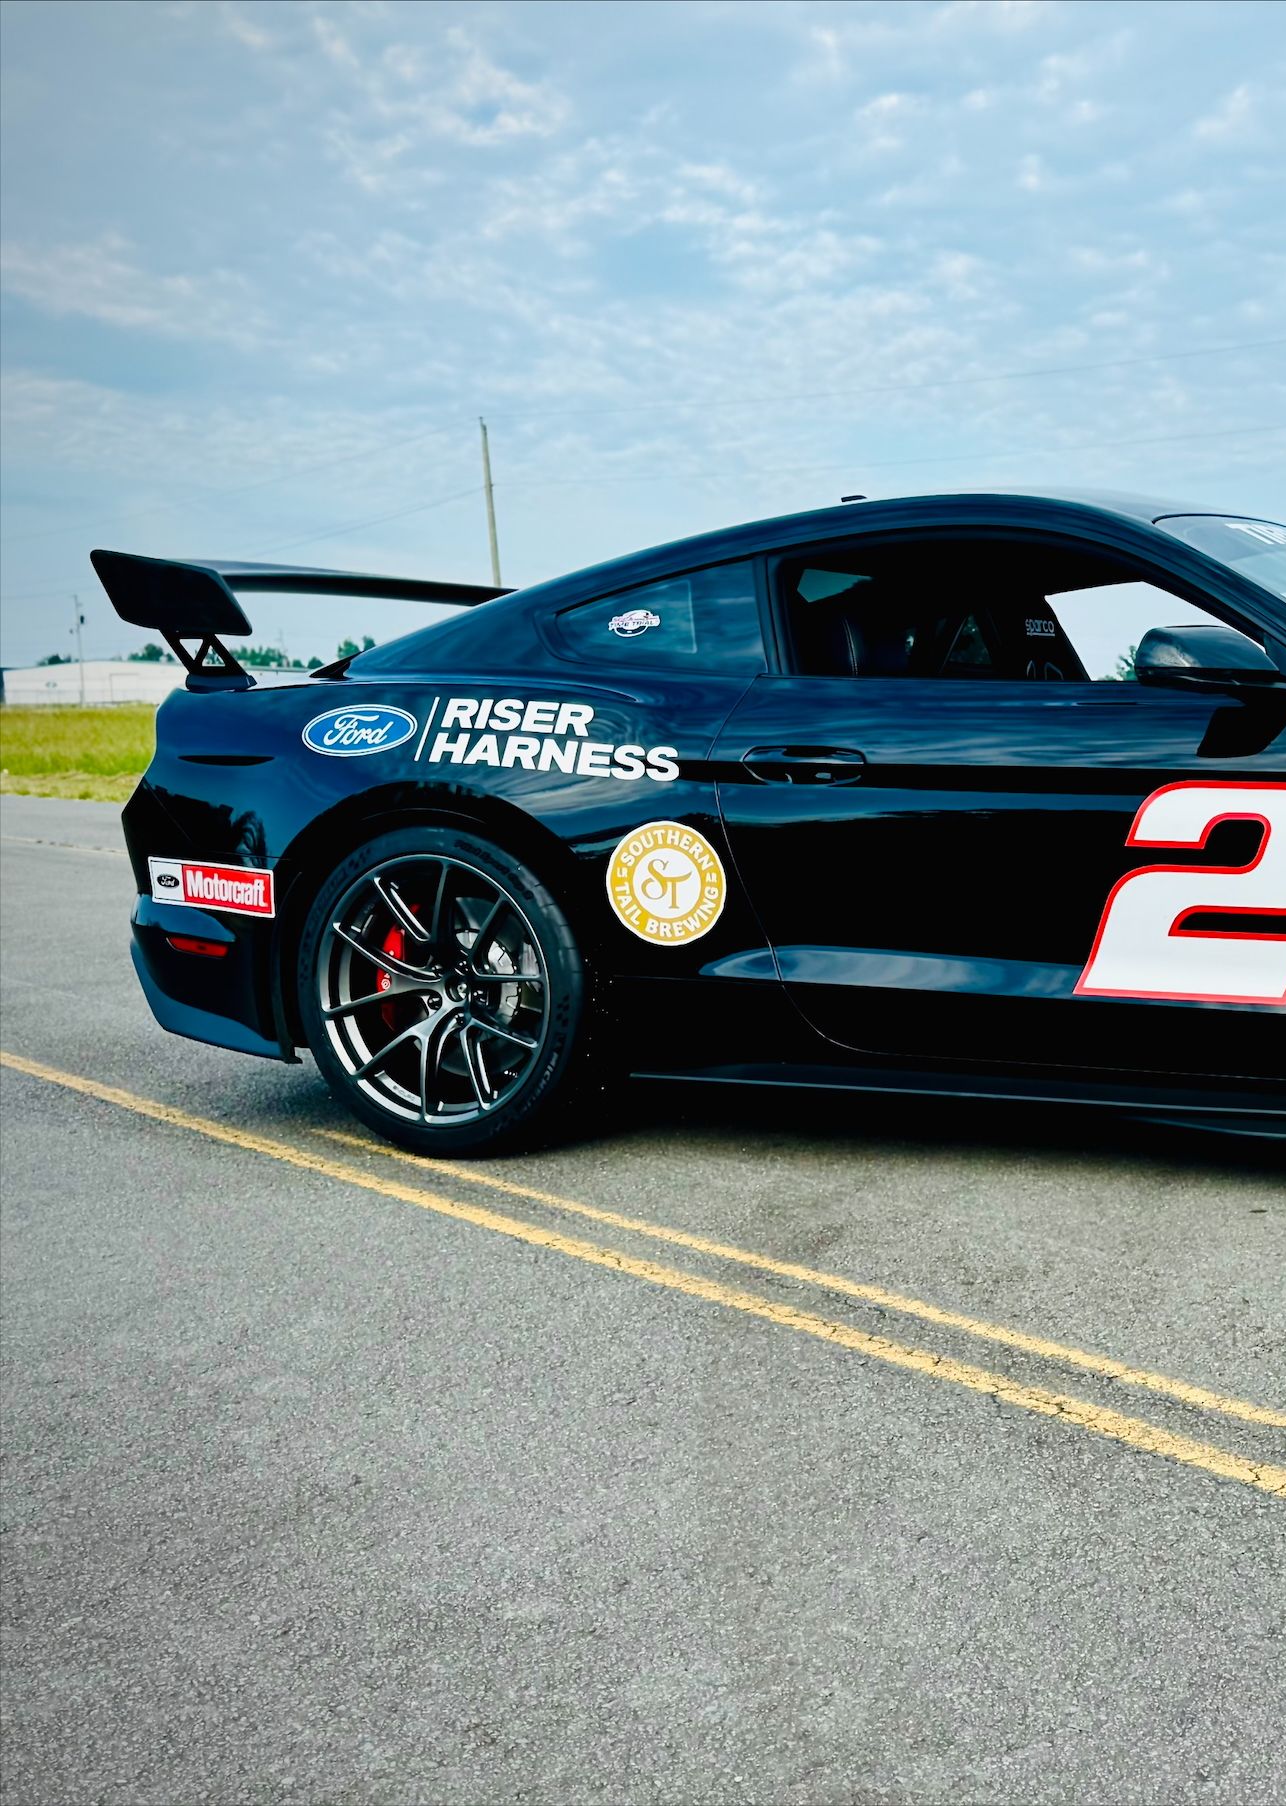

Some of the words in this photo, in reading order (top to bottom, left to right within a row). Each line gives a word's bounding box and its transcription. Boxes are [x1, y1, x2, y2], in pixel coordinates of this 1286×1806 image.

[1025, 618, 1055, 636] sparco
[440, 698, 594, 737] RISER
[428, 732, 680, 782] HARNESS
[620, 829, 714, 871] SOUTHERN
[185, 869, 266, 907] Motorcraft
[614, 881, 642, 926] TAIL
[645, 885, 719, 938] BREWING
